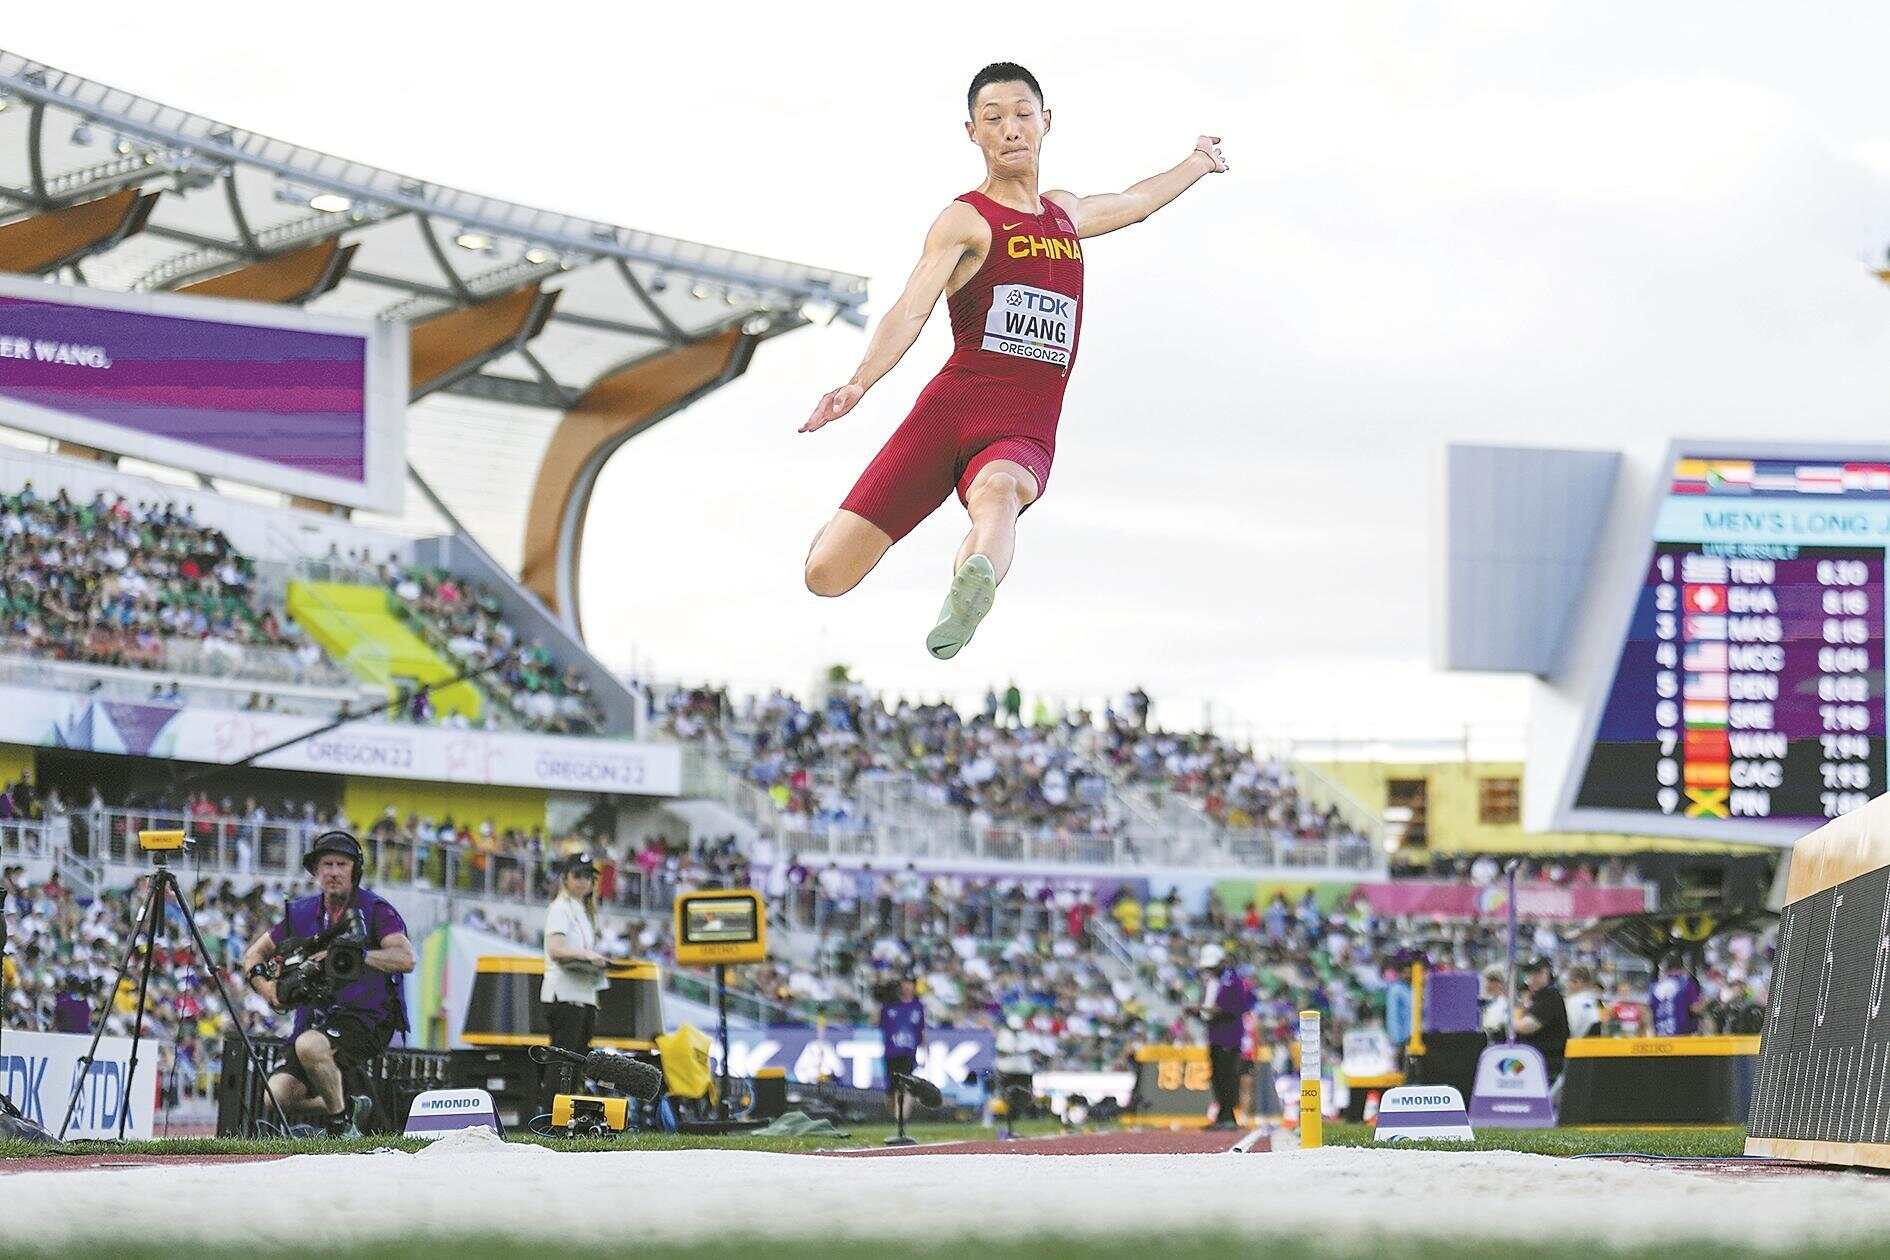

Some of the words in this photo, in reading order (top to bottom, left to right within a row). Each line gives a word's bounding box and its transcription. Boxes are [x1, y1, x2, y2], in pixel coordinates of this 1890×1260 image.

[1007, 235, 1082, 260] CHINA
[1024, 291, 1069, 318] TDK
[1005, 311, 1066, 344] WANG
[999, 341, 1066, 363] OREGON22
[1704, 511, 1784, 533] MEN'S
[1791, 513, 1869, 534] LONG
[431, 1098, 480, 1109] MONDO
[1401, 1095, 1451, 1105] MONDO
